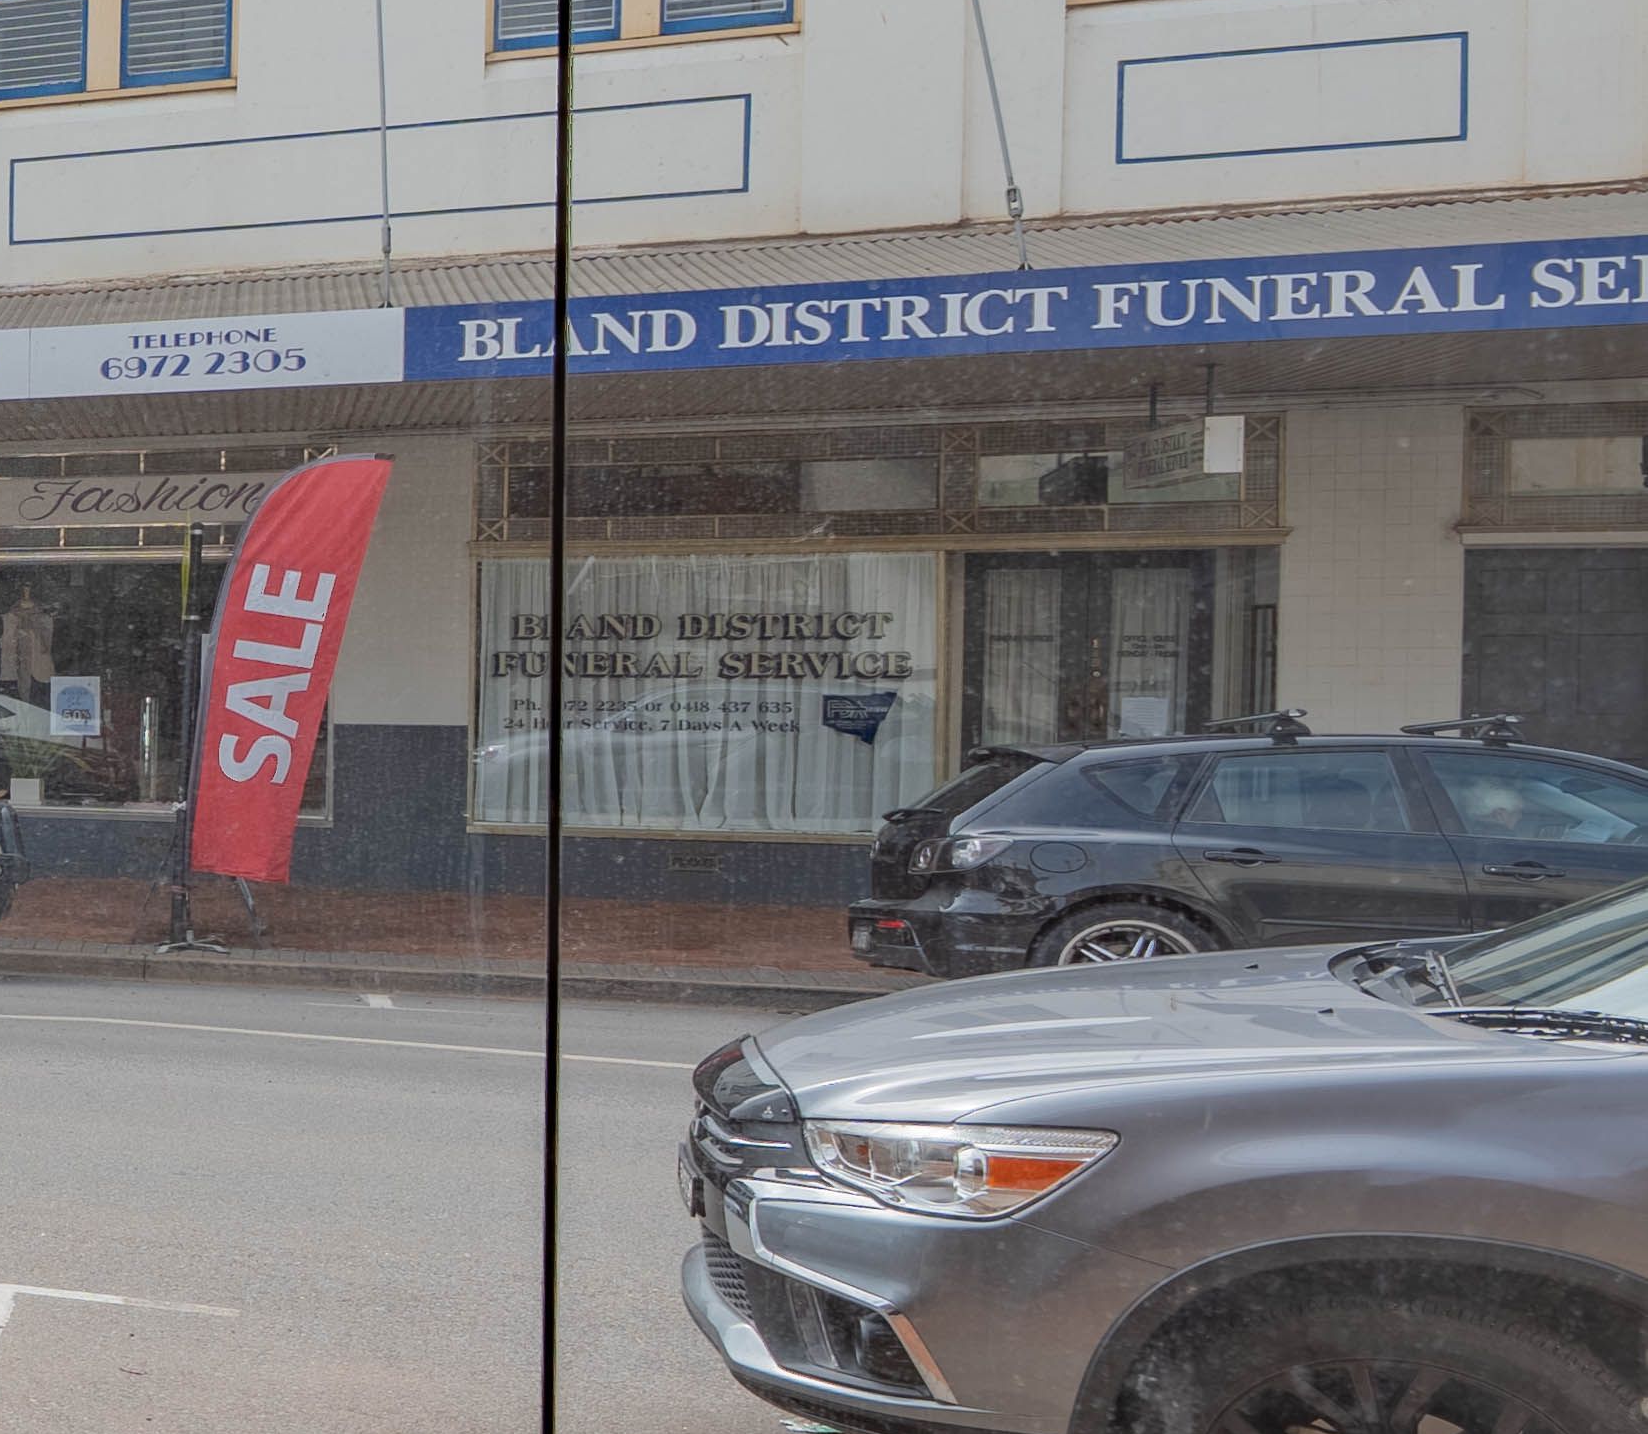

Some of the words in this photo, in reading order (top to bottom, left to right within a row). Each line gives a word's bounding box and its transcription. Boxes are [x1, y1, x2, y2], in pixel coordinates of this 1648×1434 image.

[458, 309, 698, 362] BLAND
[718, 286, 1069, 349] DISTRICT
[1090, 263, 1506, 329] FUNERAL
[129, 327, 278, 350] TELEPHONE
[99, 353, 192, 380] 6972
[204, 348, 307, 375] 2305
[18, 477, 265, 520] Fashion
[677, 612, 895, 641] DISTRICT
[218, 563, 336, 785] SALE
[492, 651, 703, 678] FUNERAL
[718, 650, 913, 679] SERVICE
[513, 698, 542, 712] Ph.
[595, 699, 638, 712] 2235
[644, 701, 663, 712] or
[669, 700, 710, 712] 0418
[757, 701, 794, 714] 635
[503, 718, 525, 729] 24
[660, 719, 671, 731] 7
[677, 719, 723, 734] Days
[729, 719, 743, 732] A
[751, 719, 801, 733] Week
